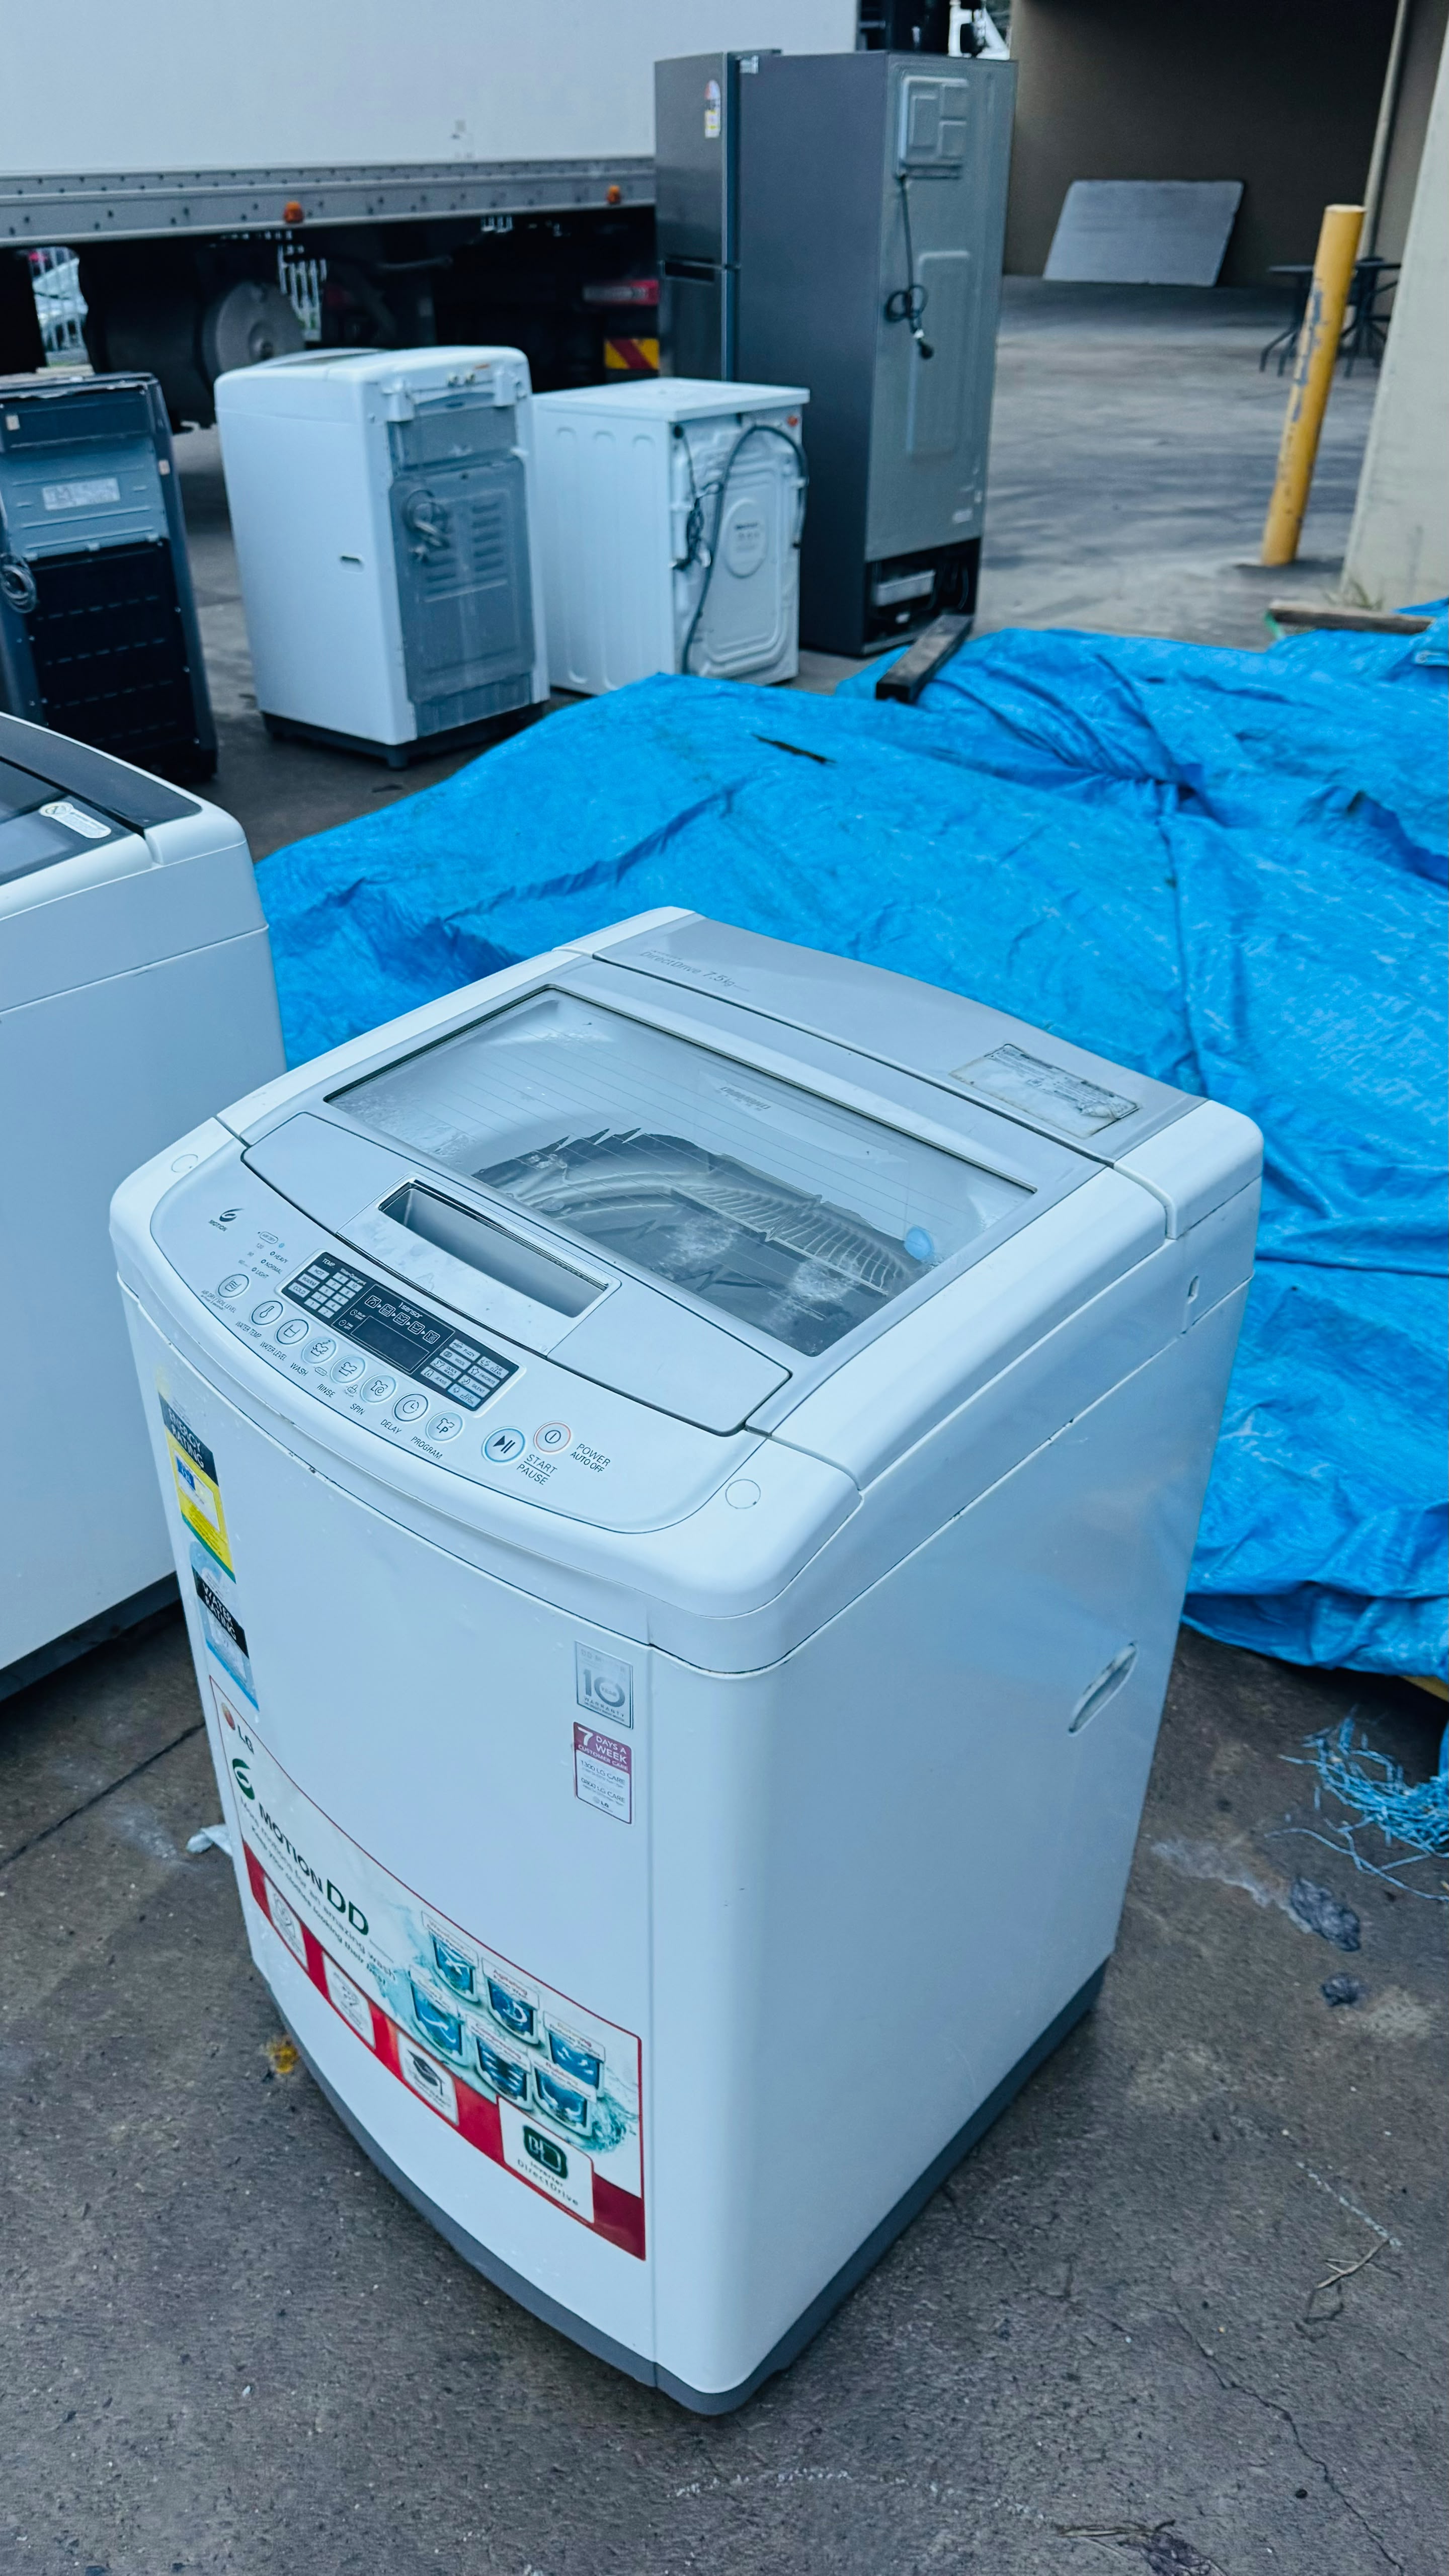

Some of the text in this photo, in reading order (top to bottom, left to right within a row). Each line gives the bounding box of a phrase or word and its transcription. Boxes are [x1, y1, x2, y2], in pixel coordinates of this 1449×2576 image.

[290, 1362, 309, 1377] WASH
[316, 1384, 336, 1398] RINSE
[350, 1403, 366, 1415] SPIN
[169, 1407, 201, 1453] ENERGY
[380, 1419, 402, 1434] DELAY
[171, 1424, 204, 1468] RATING
[411, 1435, 443, 1460] PROGRAM
[576, 1443, 611, 1467] POWER
[526, 1454, 558, 1474] START
[570, 1451, 605, 1474] AUTO OFF
[517, 1464, 549, 1485] PAUSE
[237, 1725, 255, 1755] LG
[577, 1726, 594, 1747] 7
[596, 1735, 618, 1751] DAYS
[578, 1744, 611, 1763] CUSTOMER
[595, 1743, 627, 1765] WEEK
[259, 1802, 323, 1894] MOTION
